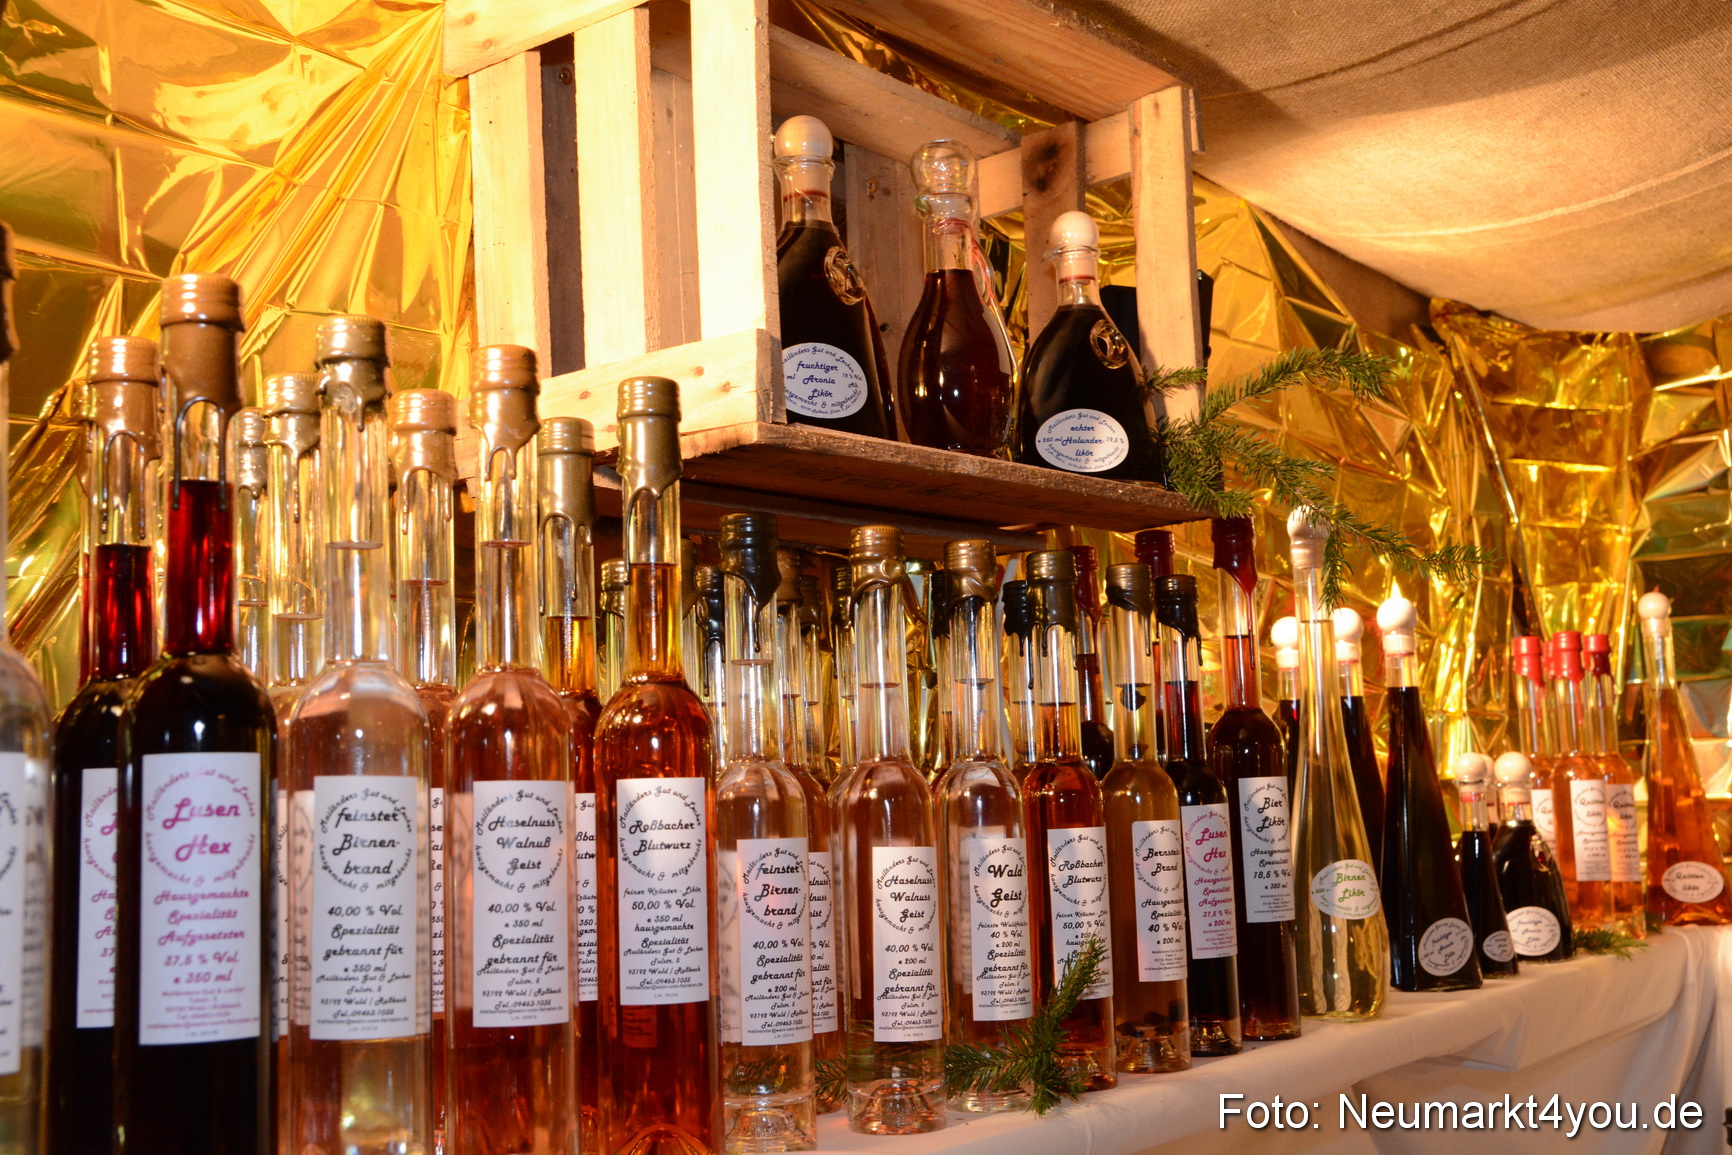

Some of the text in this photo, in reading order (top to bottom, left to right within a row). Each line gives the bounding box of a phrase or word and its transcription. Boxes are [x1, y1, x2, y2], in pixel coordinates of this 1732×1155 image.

[811, 346, 837, 357] Gut und
[796, 361, 838, 373] fruchtiger
[802, 374, 836, 384] Aronia
[808, 388, 833, 400] Likör
[1048, 414, 1076, 434] Mailänders
[1078, 412, 1088, 420] Gut
[1062, 437, 1104, 446] Holunder-
[218, 773, 238, 784] und
[320, 788, 399, 834] Mailänders Gut und
[580, 800, 595, 811] Gut
[619, 786, 701, 828] Mailänders Gut und Lecker
[1257, 798, 1282, 814] Bier
[162, 798, 240, 830] Lusen
[334, 807, 400, 828] feinster
[476, 790, 552, 836] Mailänders Gut und
[488, 816, 556, 831] Haselnuss
[628, 819, 695, 834] Roßbacher
[1256, 816, 1286, 832] Likör
[496, 836, 552, 848] Walnuß
[1195, 828, 1228, 846] Lusen
[175, 834, 232, 862] Hex
[332, 834, 400, 856] Birnen-
[632, 840, 691, 856] Blutwurz
[1050, 838, 1076, 868] Mailänders
[1078, 834, 1088, 844] Gut
[619, 837, 702, 878] hausgemacht mitgebracht
[974, 844, 1013, 876] Mailänders Gut
[1204, 847, 1226, 862] Hex
[319, 844, 357, 890] hausgemacht
[344, 860, 393, 874] brand
[475, 844, 515, 890] hausgemacht
[506, 858, 542, 876] Geist
[742, 848, 799, 884] Mailänders Gut und
[755, 862, 800, 880] feinster
[988, 864, 1022, 878] Wald
[1058, 859, 1104, 872] Roßbacher
[1150, 862, 1178, 876] Brand
[876, 856, 929, 890] Mailänders Gut und
[1332, 872, 1366, 887] Birnen
[884, 875, 932, 888] Haselnuss
[1062, 875, 1102, 888] Blutwurz
[154, 888, 249, 905] Hausgemachte
[623, 888, 644, 898] feiner
[648, 888, 678, 896] Kräuter
[754, 884, 800, 902] Birnen-
[890, 892, 930, 902] Walnuss
[1050, 874, 1080, 906] hausgemacht
[1338, 888, 1366, 902] Likör
[632, 898, 696, 910] 50,00 Vol.
[974, 884, 1002, 916] hausgemacht
[990, 888, 1022, 908] Geist
[328, 904, 404, 918] 40,00 Vol.
[488, 901, 556, 914] 40,00 Vol.
[742, 892, 776, 928] hausgemacht
[764, 903, 798, 916] brand
[168, 908, 238, 925] Spezialität
[672, 914, 683, 922] ml
[876, 898, 906, 932] hausgemacht
[900, 908, 924, 922] Geist
[1056, 912, 1072, 920] feiner
[513, 919, 544, 928] 350 ml
[634, 922, 694, 935] hausgemachte
[1063, 922, 1084, 930] 50,00
[1148, 924, 1160, 932] 40
[157, 930, 246, 946] Aufgesetzter
[331, 924, 400, 940] Spezialität
[492, 934, 554, 949] Spezialität
[641, 937, 689, 949] Spezialität
[753, 940, 778, 950] 40,00
[884, 944, 910, 953] 40,00
[323, 944, 404, 961] gebrannt für
[624, 948, 675, 956] Mailänders Gut
[164, 954, 192, 966] 37,5
[485, 952, 558, 969] gebrannt für
[756, 954, 803, 968] Spezialität
[918, 956, 927, 964] ml
[352, 964, 388, 972] 350 ml
[888, 968, 934, 980] Spezialität
[982, 964, 1019, 976] gebrannt
[215, 970, 234, 981] ml
[750, 968, 806, 984] gebrannt für
[882, 982, 936, 996] gebrannt für
